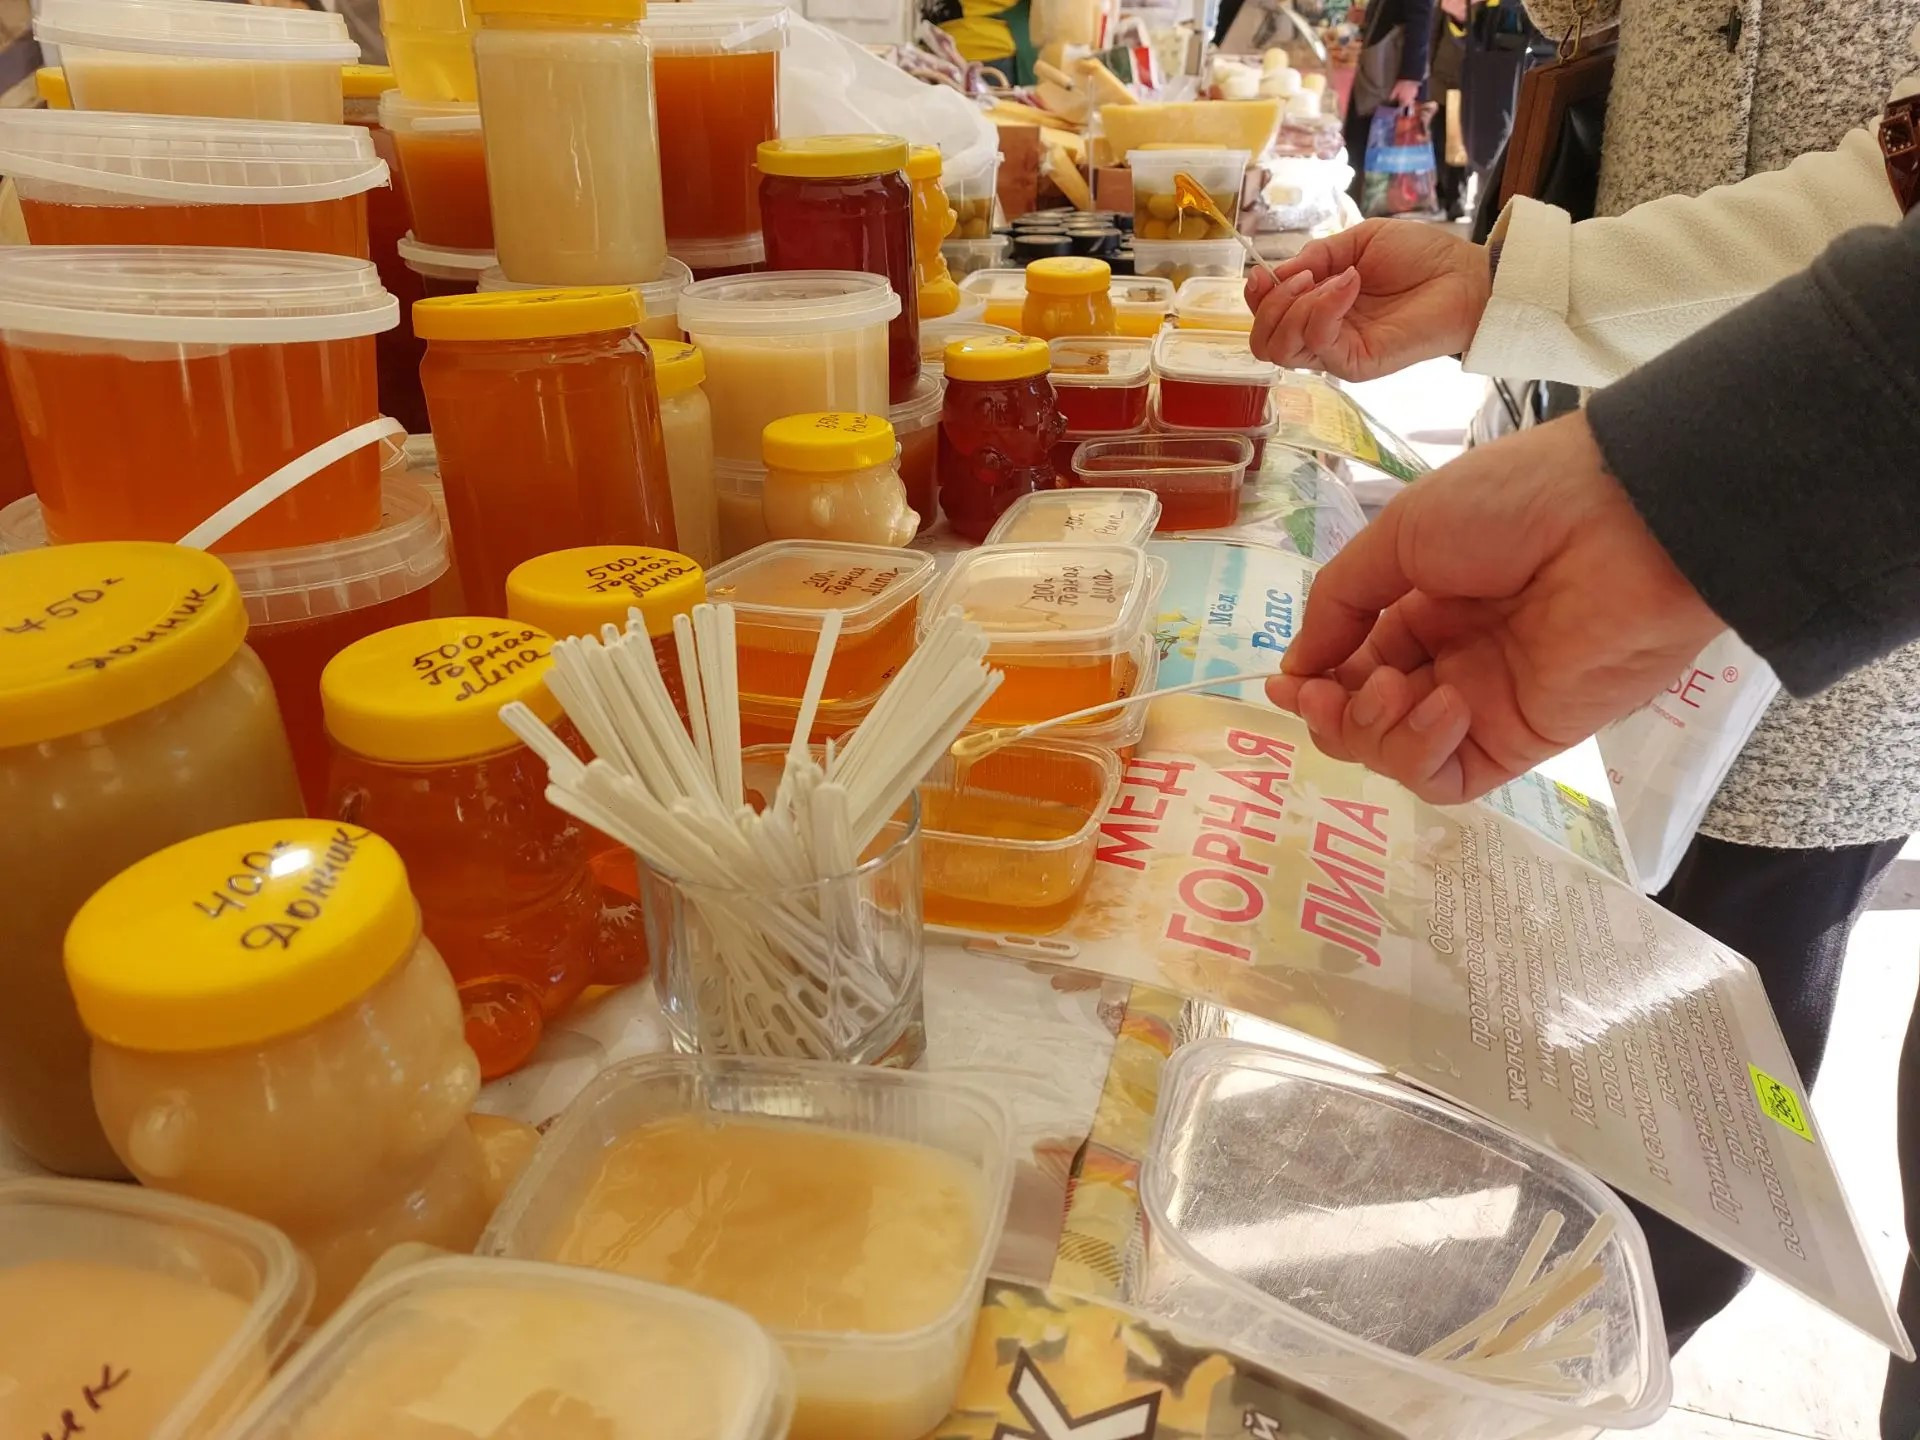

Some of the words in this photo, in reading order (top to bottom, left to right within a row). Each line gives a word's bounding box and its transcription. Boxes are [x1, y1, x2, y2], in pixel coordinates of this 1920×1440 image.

[1207, 592, 1238, 627] Мёд
[1252, 588, 1293, 653] Рапс
[1096, 757, 1196, 871] МЕД
[1166, 727, 1296, 962] ГОРНАЯ
[1300, 797, 1390, 968] ЛИПА
[1429, 863, 1456, 955] Обладает
[1552, 952, 1576, 992] для
[1646, 1157, 1672, 1185] и
[1678, 1058, 1743, 1224] Применяется
[1725, 1128, 1755, 1175] при
[1738, 1101, 1806, 1260] воспалении
